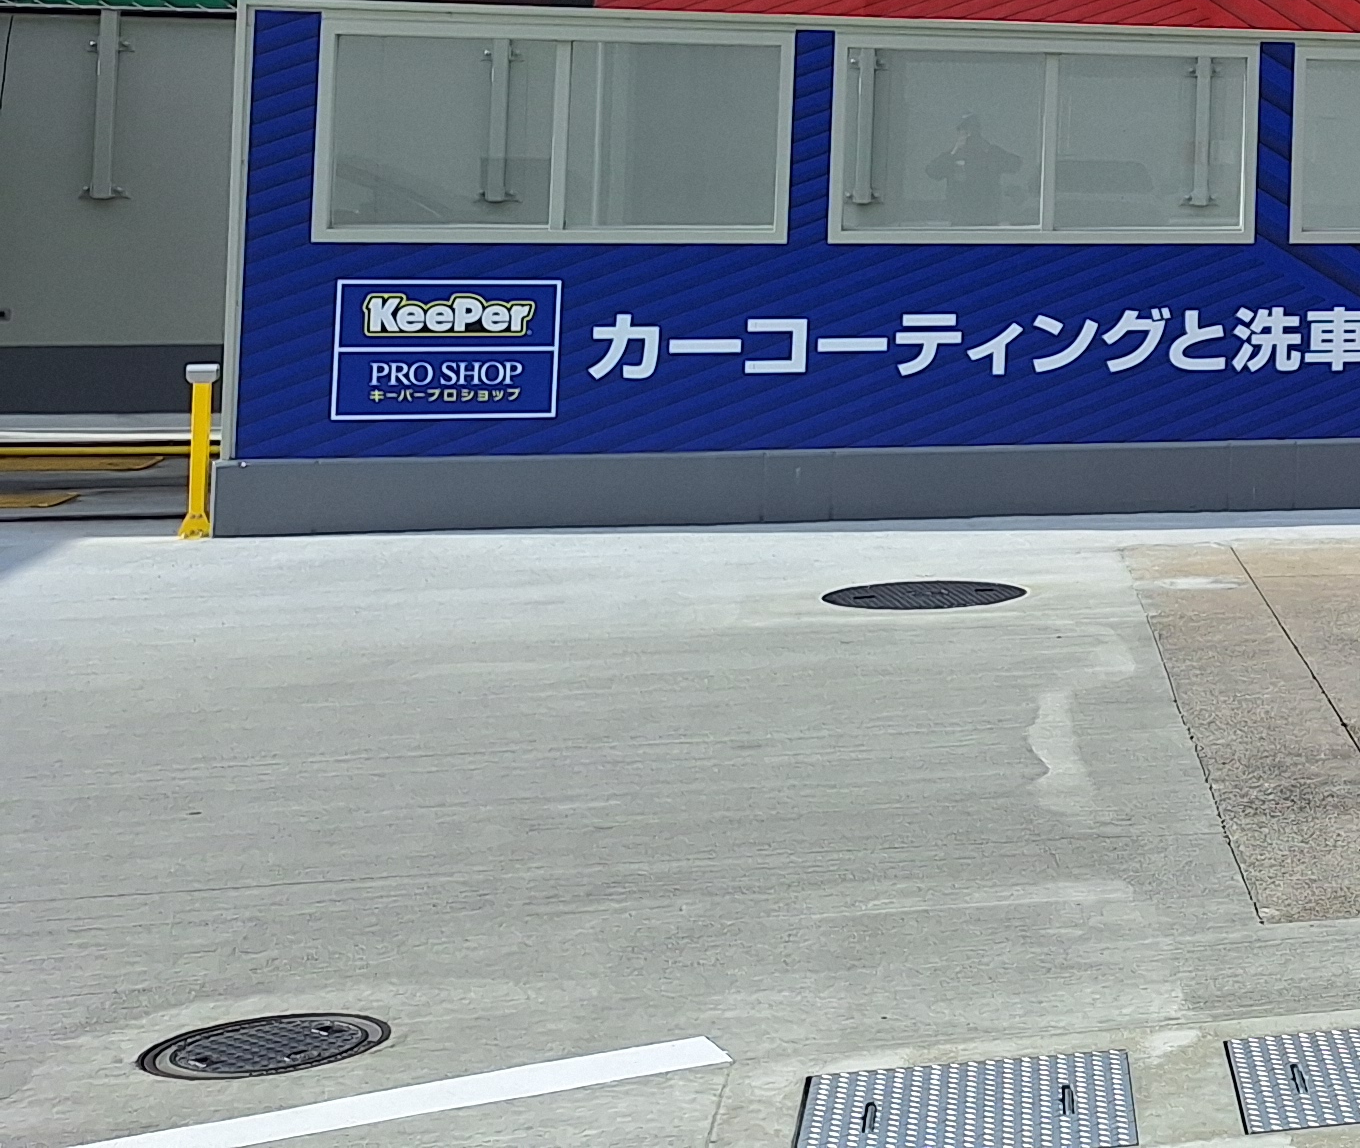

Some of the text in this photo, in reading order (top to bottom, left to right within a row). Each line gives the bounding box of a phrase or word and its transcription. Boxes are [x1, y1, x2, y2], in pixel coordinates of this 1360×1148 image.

[366, 295, 533, 334] KeePer
[369, 361, 523, 386] PRO SHOP
